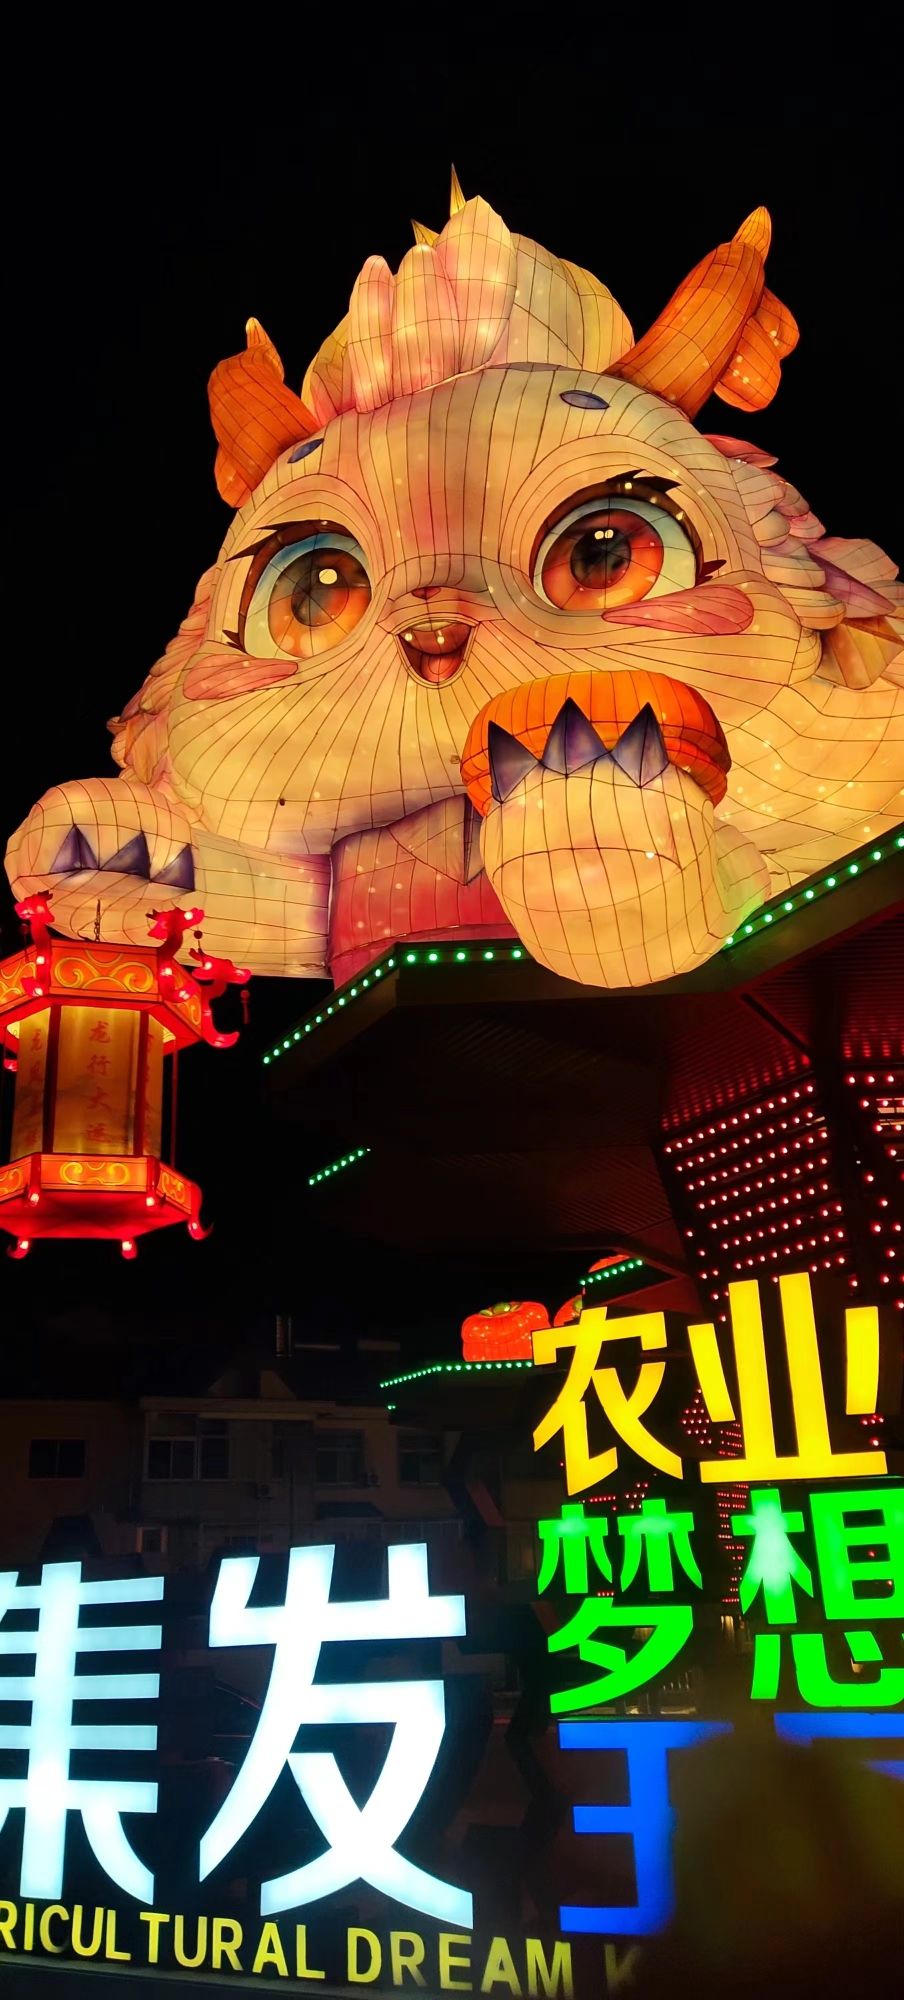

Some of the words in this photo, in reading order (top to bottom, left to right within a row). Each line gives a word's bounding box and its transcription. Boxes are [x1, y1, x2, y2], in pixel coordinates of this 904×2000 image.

[531, 1272, 888, 1497] 农业
[537, 1488, 904, 1714] 梦想
[0, 1543, 474, 1930] 集发
[347, 1927, 574, 2000] DREAM
